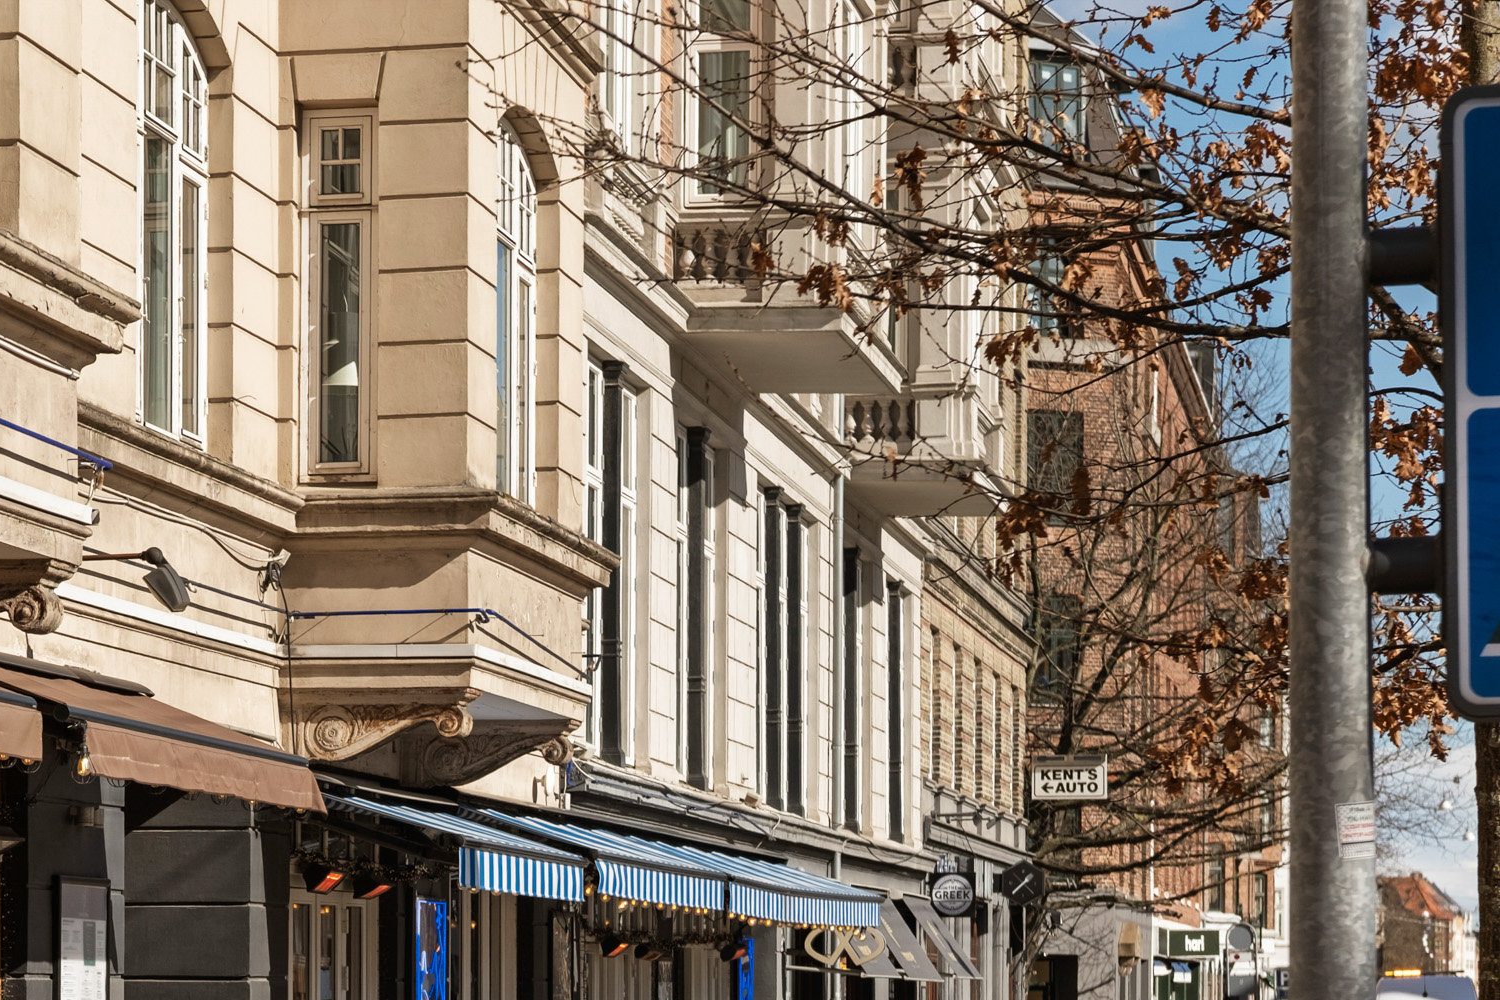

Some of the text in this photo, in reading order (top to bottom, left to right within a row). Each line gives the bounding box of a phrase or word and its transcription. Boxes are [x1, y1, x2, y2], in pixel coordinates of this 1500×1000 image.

[1040, 768, 1098, 781] KENT'S
[1055, 782, 1099, 794] AUTO
[934, 890, 971, 900] GREEK
